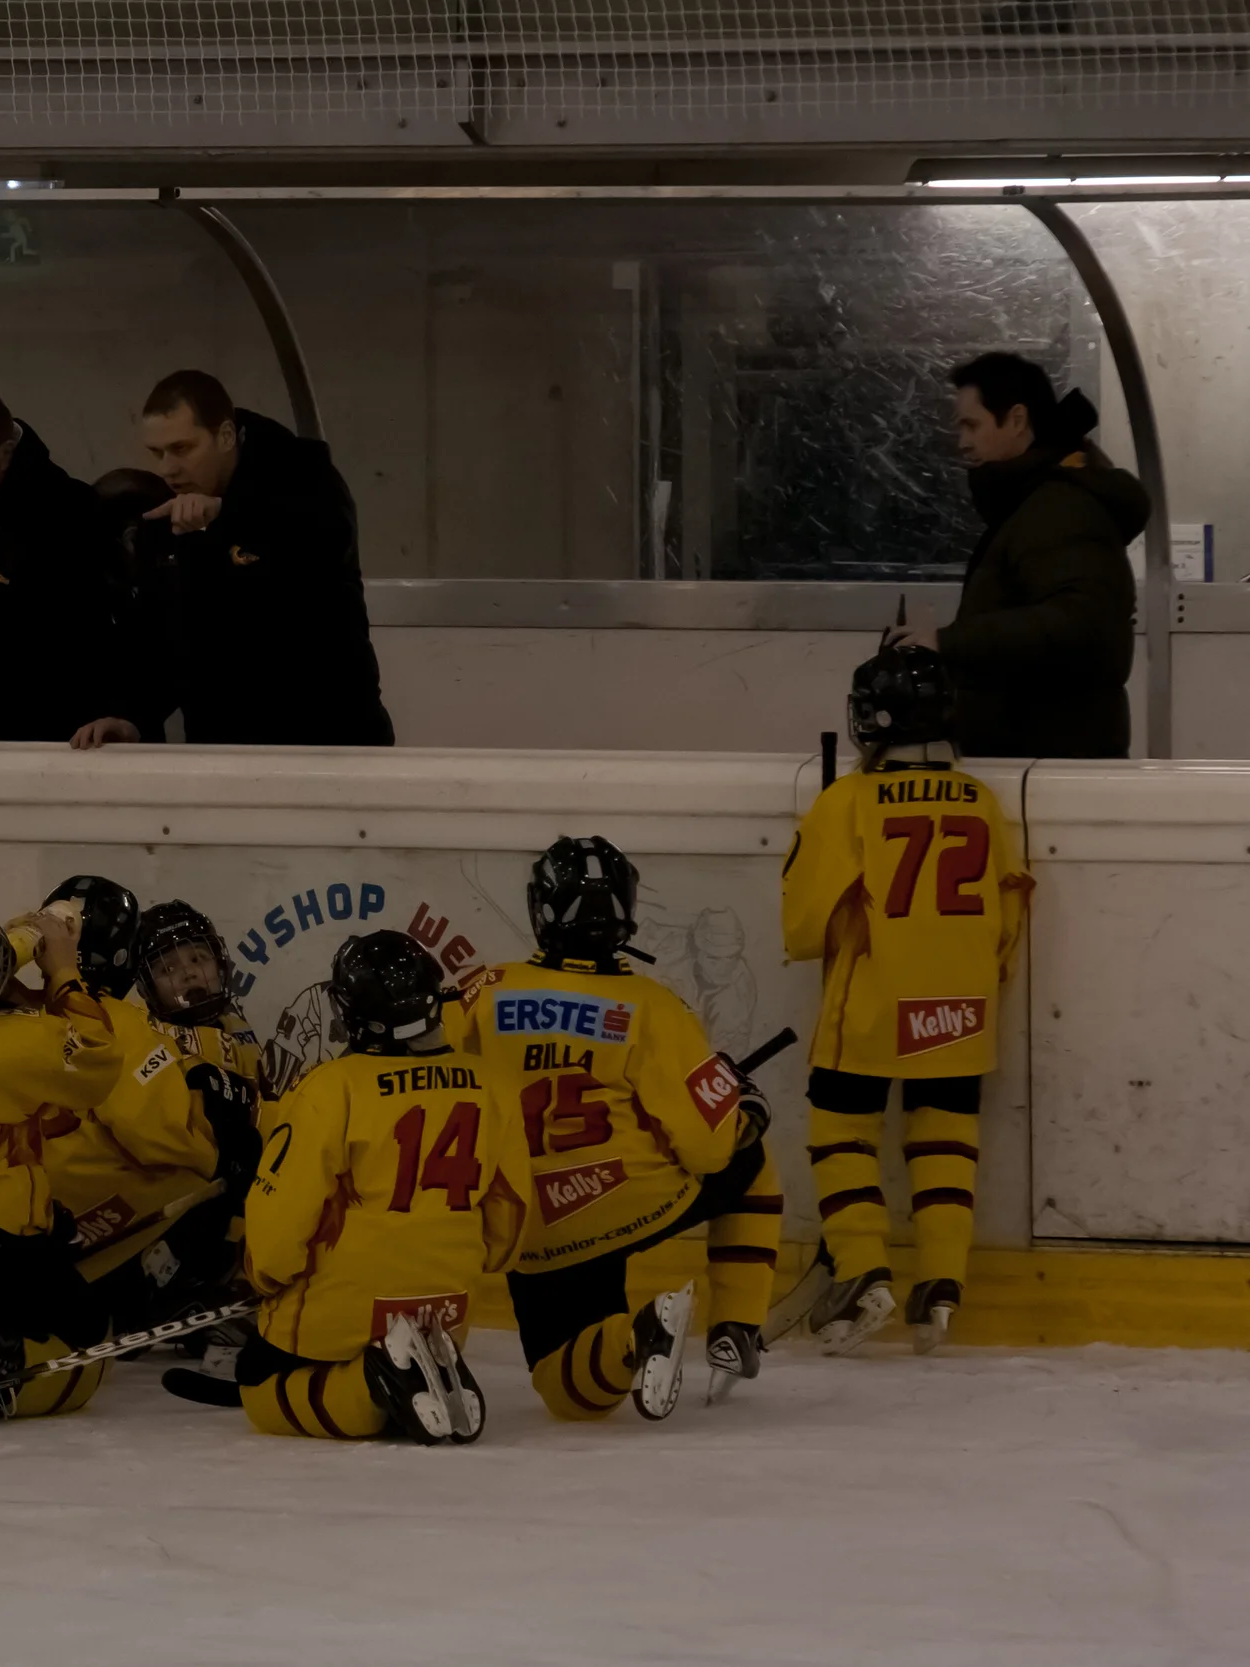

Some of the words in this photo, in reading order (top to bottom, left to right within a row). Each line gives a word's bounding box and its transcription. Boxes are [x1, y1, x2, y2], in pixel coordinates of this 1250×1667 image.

[878, 778, 978, 804] KILLIUS
[882, 815, 990, 919] 72
[497, 998, 600, 1037] ERSTE
[601, 1030, 627, 1043] BANK
[908, 1002, 978, 1040] Kelly's
[140, 1046, 168, 1078] KSV
[377, 1066, 483, 1097] STEINDL
[520, 1072, 613, 1158] 15
[386, 1101, 483, 1213] 14
[546, 1165, 616, 1210] Kelly's
